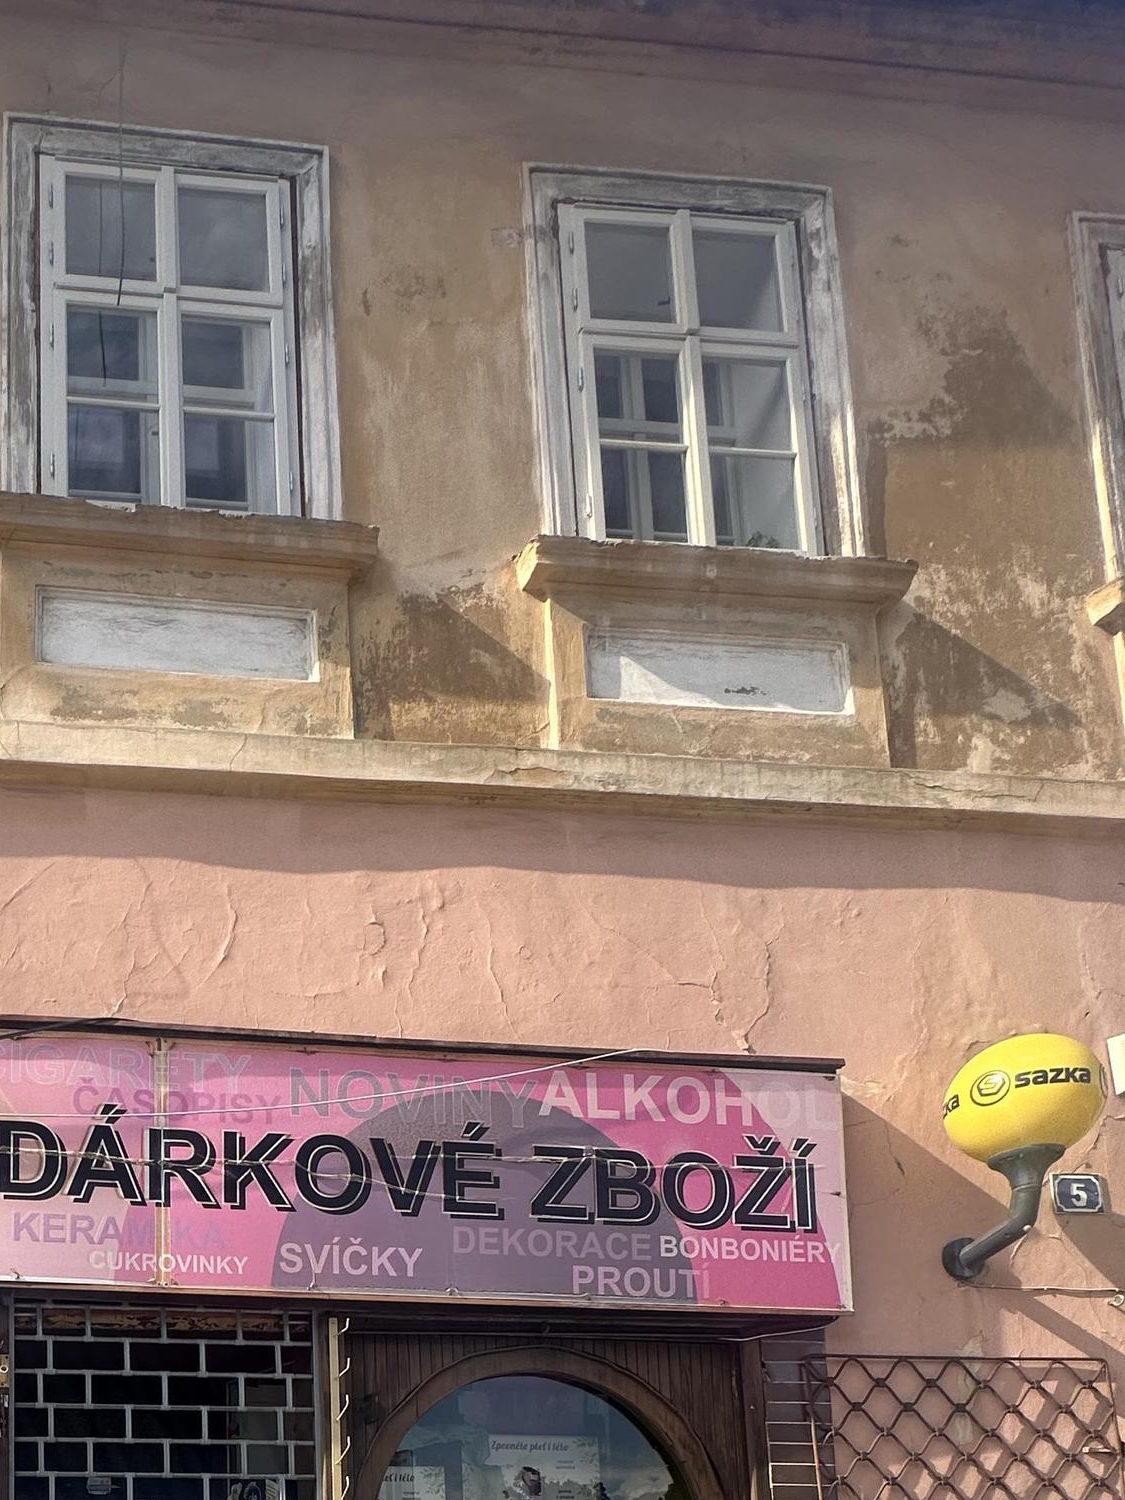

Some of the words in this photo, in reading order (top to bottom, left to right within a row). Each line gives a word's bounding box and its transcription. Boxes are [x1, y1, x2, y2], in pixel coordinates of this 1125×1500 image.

[73, 1076, 282, 1126] ČASOPISY
[289, 1067, 538, 1129] NOVINY
[538, 1069, 841, 1131] ALKOHOL
[528, 1134, 819, 1235] ZBOŽÍ
[1070, 1182, 1088, 1208] 5
[13, 1212, 226, 1249] KERAMKA
[452, 1225, 652, 1262] DEKORACE
[658, 1234, 841, 1264] BONBONIÉRY
[88, 1248, 249, 1275] CUKROVINKY
[279, 1236, 423, 1278] SVÍČKY
[572, 1263, 710, 1299] PROUTÍ
